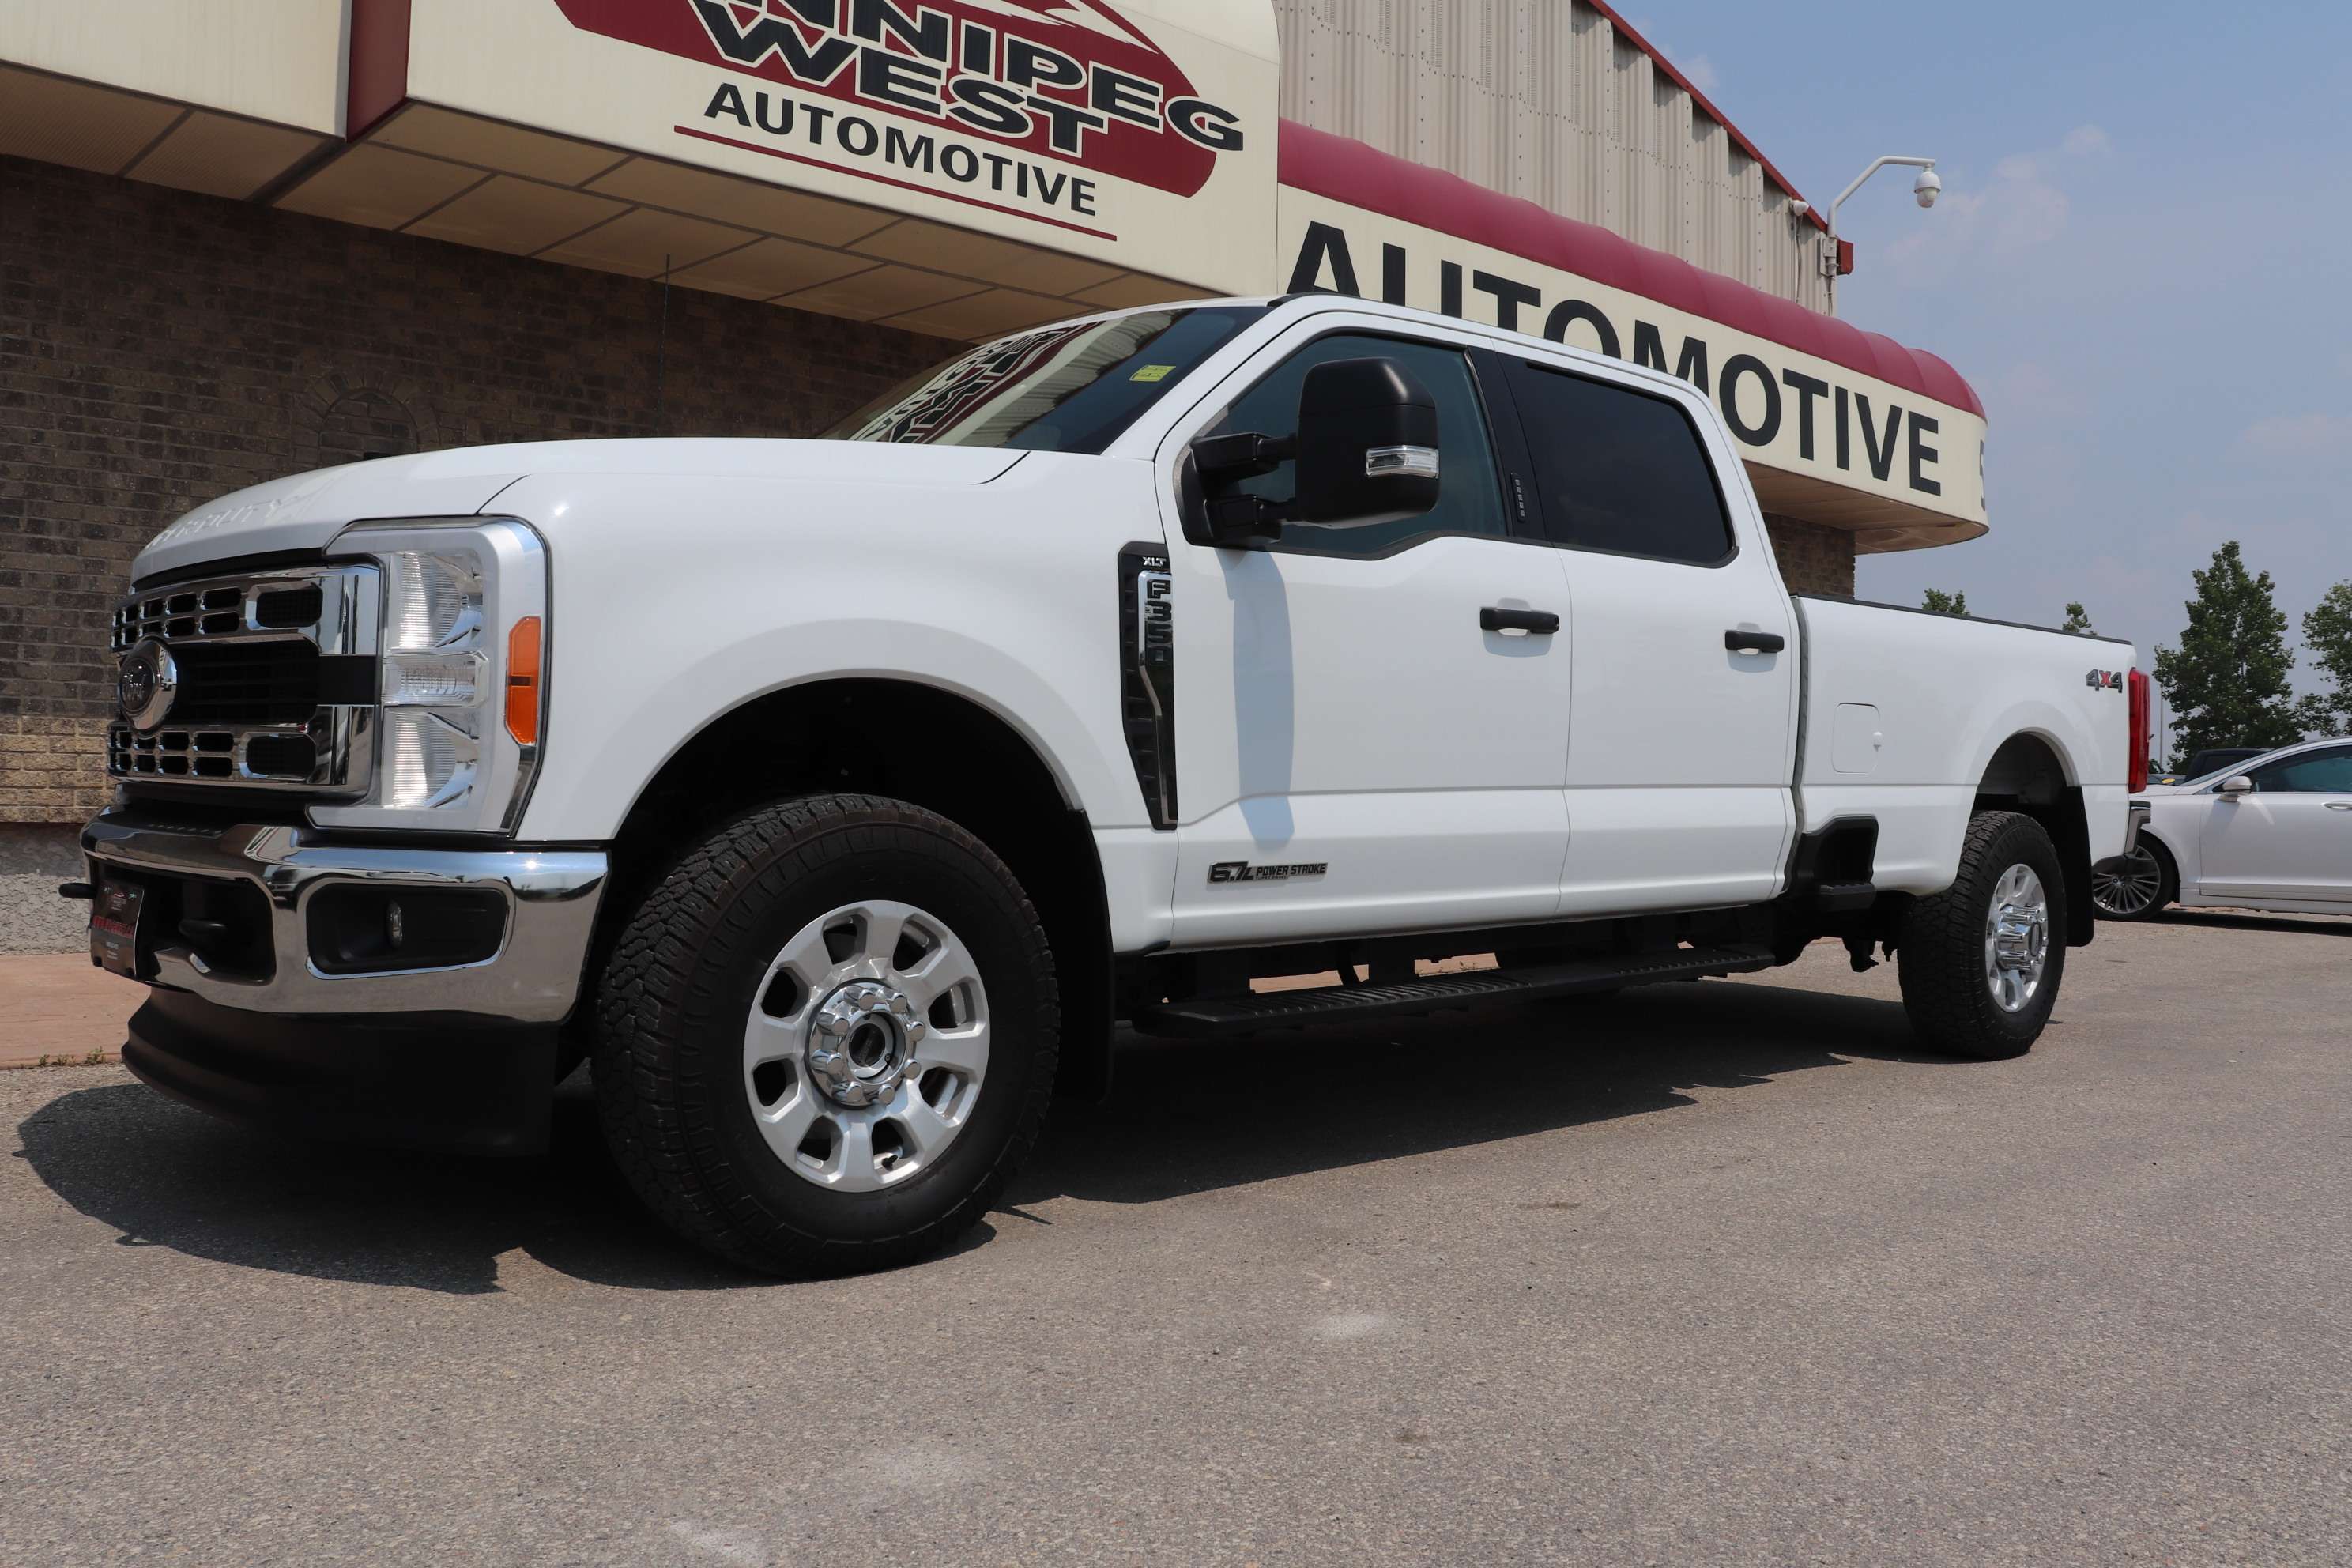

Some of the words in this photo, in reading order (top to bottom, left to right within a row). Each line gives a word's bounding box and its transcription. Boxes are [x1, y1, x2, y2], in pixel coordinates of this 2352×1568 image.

[694, 0, 1105, 153] WEST
[704, 82, 1095, 217] AUTOMOTIVE
[1143, 556, 1166, 567] XLT
[1208, 861, 1254, 882] 6.7L
[1255, 865, 1289, 876] POWER
[1291, 863, 1328, 875] STROKE
